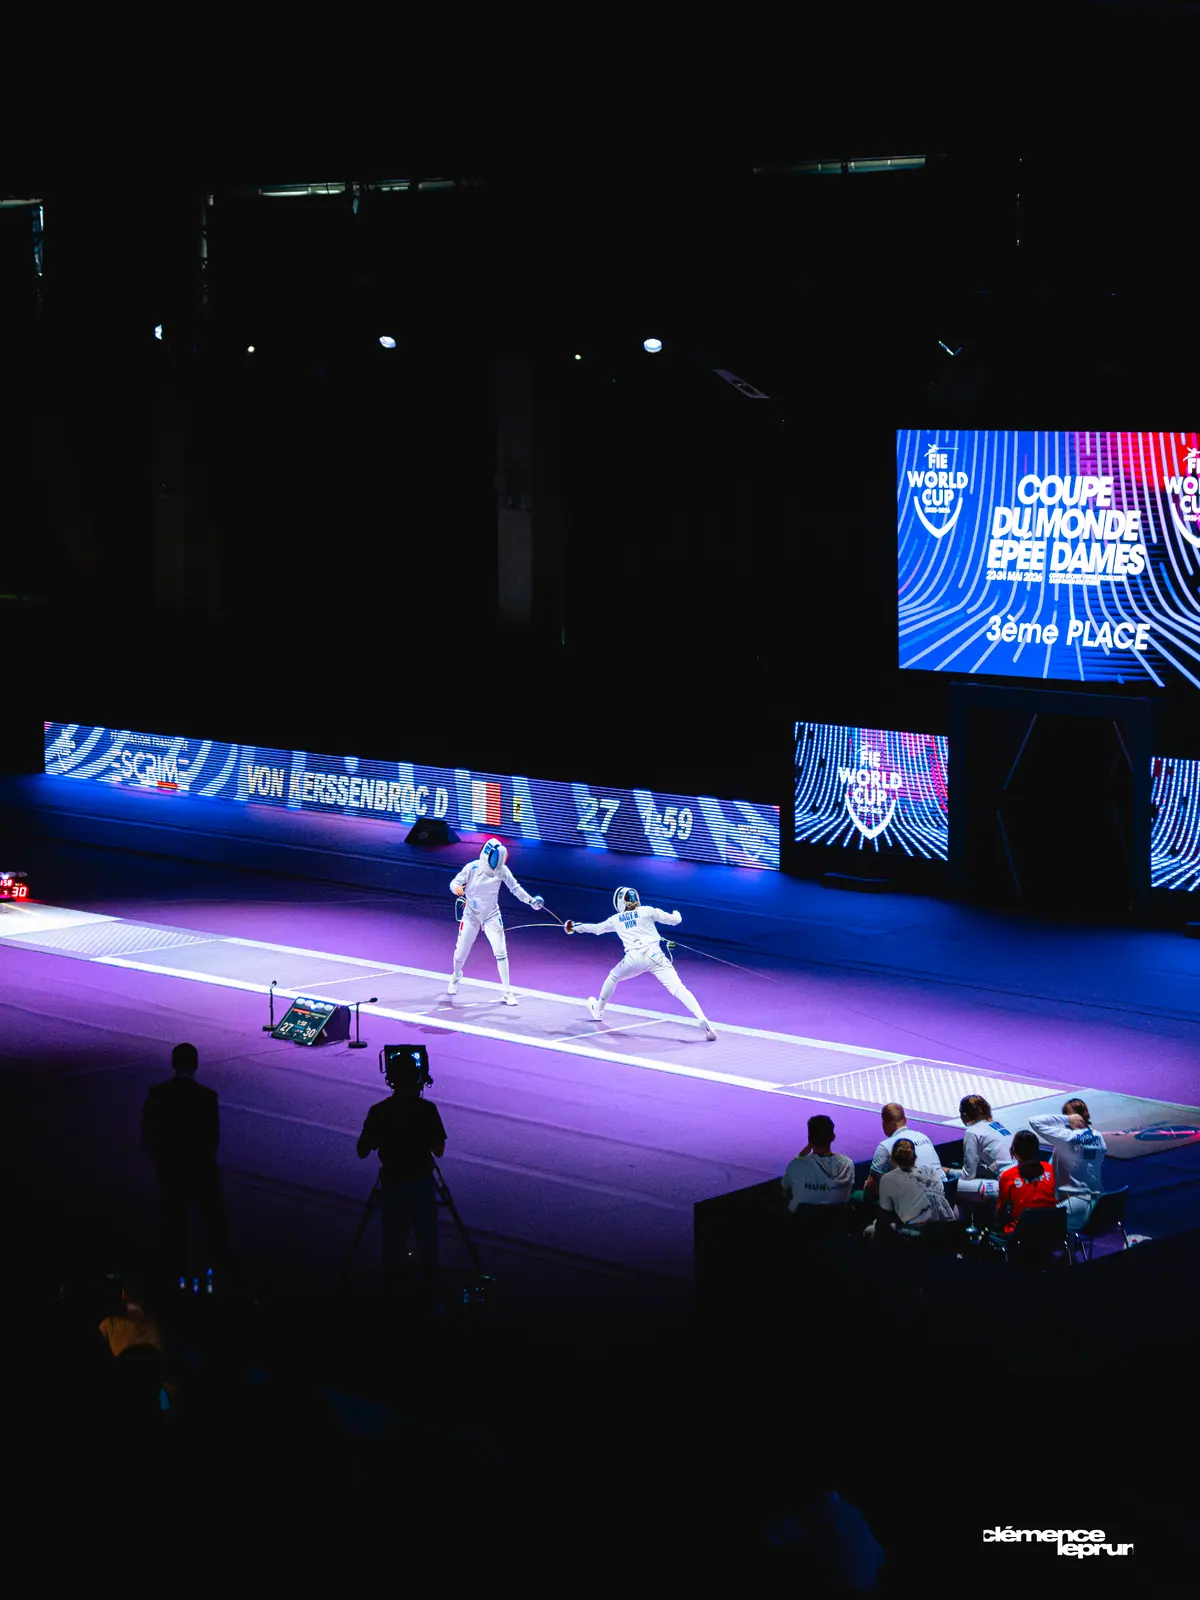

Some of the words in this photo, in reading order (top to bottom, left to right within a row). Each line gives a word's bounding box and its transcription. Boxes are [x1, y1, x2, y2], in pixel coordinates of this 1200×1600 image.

[928, 453, 948, 469] FIE
[1187, 457, 1200, 475] FI
[907, 470, 969, 489] WORLD
[922, 488, 955, 506] CUP
[1017, 474, 1114, 507] COUPE
[1180, 494, 1200, 514] CU
[992, 506, 1032, 538] DU
[1036, 507, 1141, 541] MONDE
[1050, 541, 1147, 575] DAMES
[986, 614, 1059, 644] 3ème
[1067, 620, 1151, 650] PLACE
[860, 751, 880, 767] FIE
[838, 766, 902, 789] WORLD
[247, 765, 285, 798] VON
[433, 787, 449, 818] D
[577, 796, 620, 834] 27
[853, 787, 887, 806] CUP
[12, 887, 27, 897] 30
[280, 1022, 294, 1033] 27
[302, 1027, 316, 1038] 30
